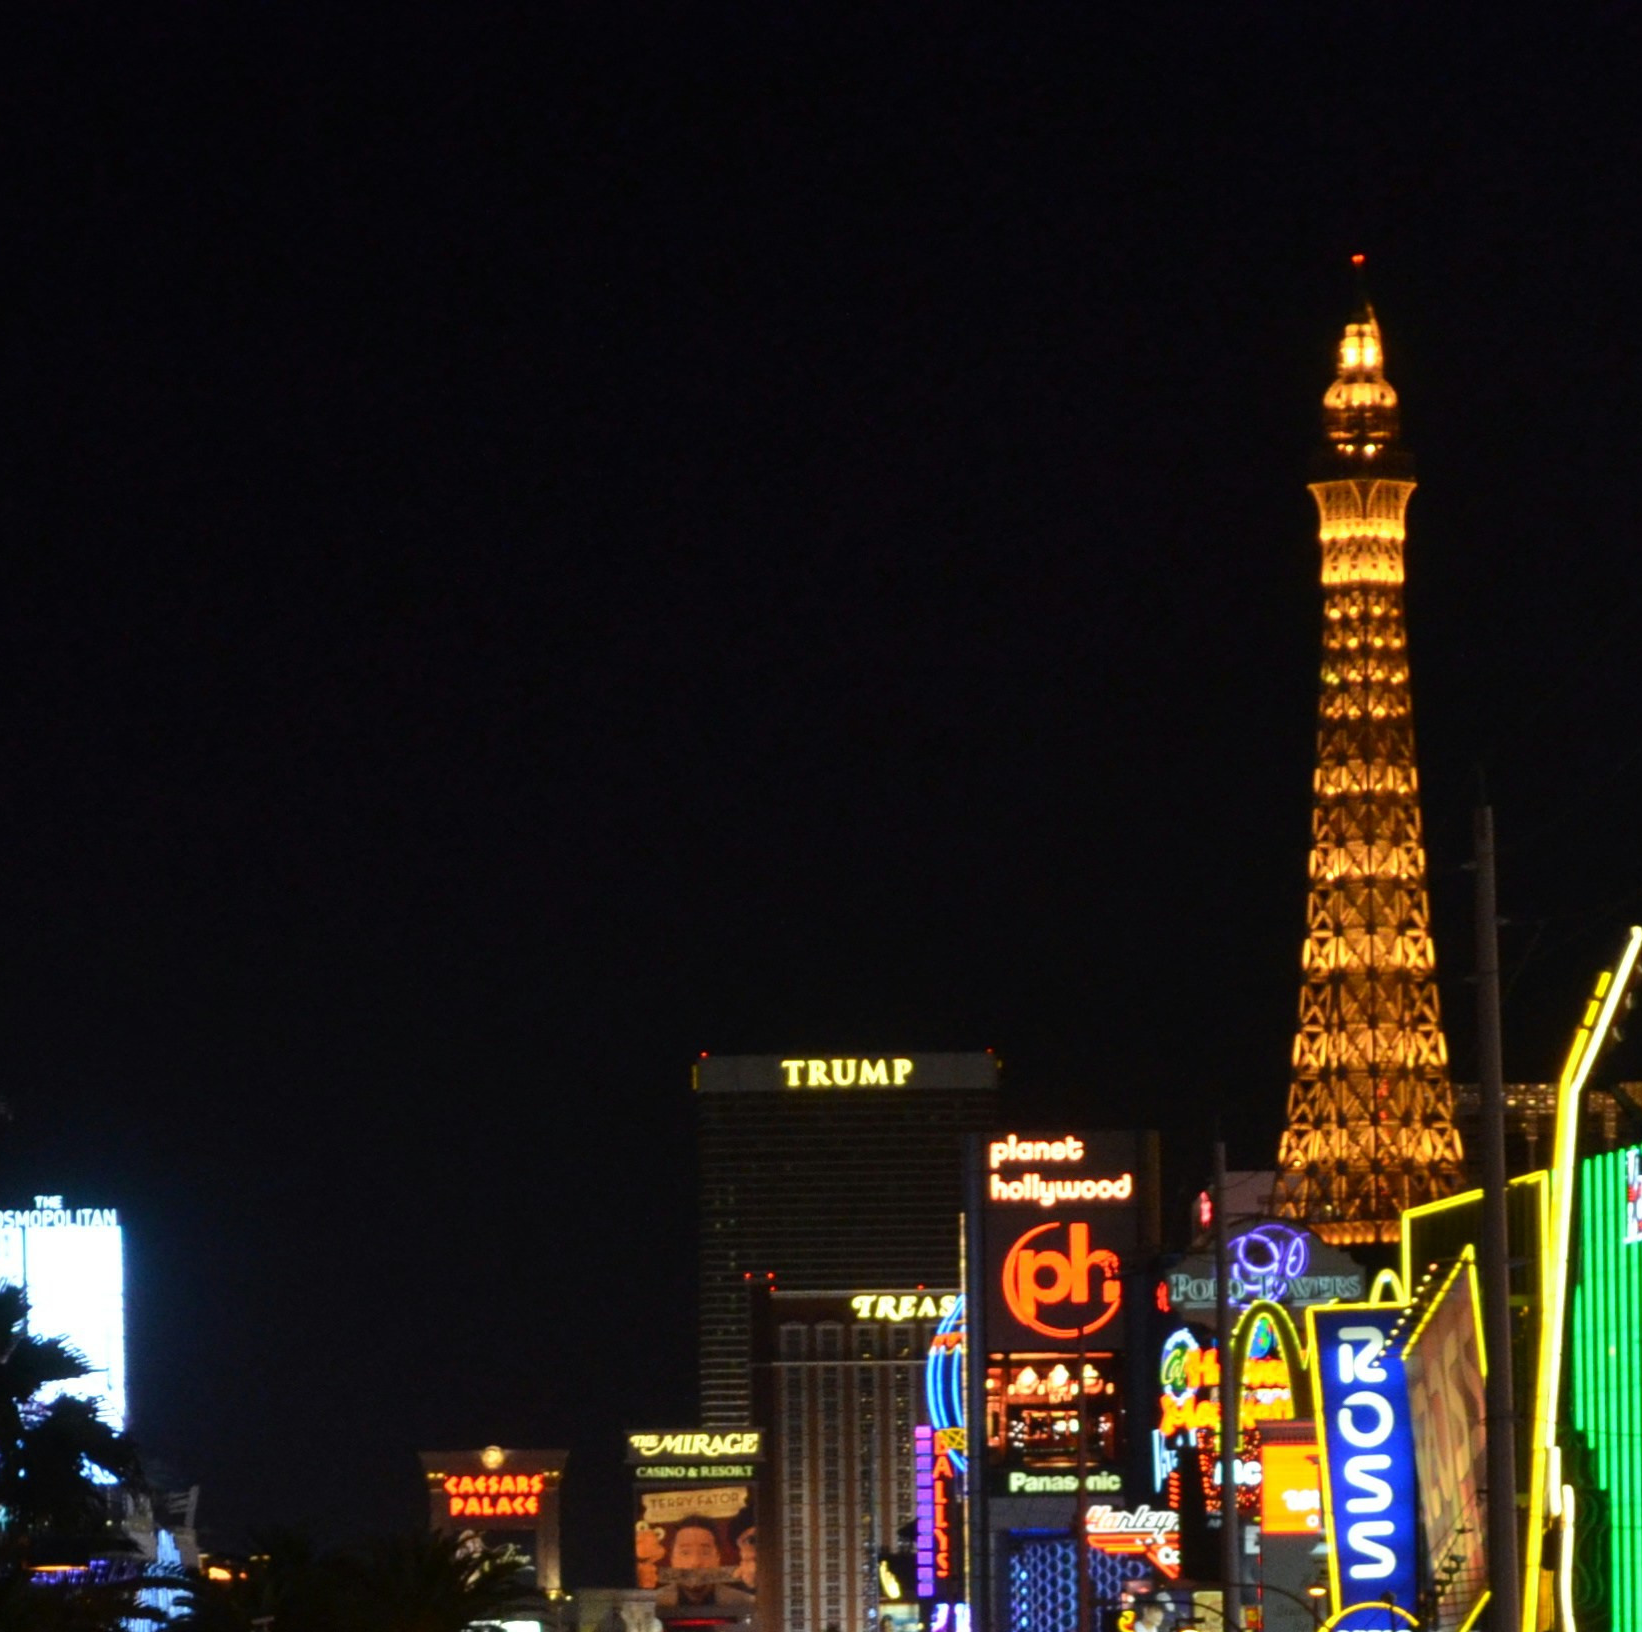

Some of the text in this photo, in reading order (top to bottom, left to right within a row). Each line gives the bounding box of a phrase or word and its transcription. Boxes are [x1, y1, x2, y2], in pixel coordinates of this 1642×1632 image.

[781, 1058, 914, 1087] TRUMP
[989, 1133, 1085, 1170] planet
[989, 1172, 1133, 1208] hollywood
[34, 1195, 63, 1209] THE
[645, 1433, 760, 1457] MIRAGE
[1337, 1324, 1397, 1581] ROSS
[636, 1464, 754, 1480] CASINO & RESORT
[1008, 1470, 1122, 1493] Panasnic
[444, 1473, 545, 1495] CAESARS
[449, 1495, 540, 1517] PALACE
